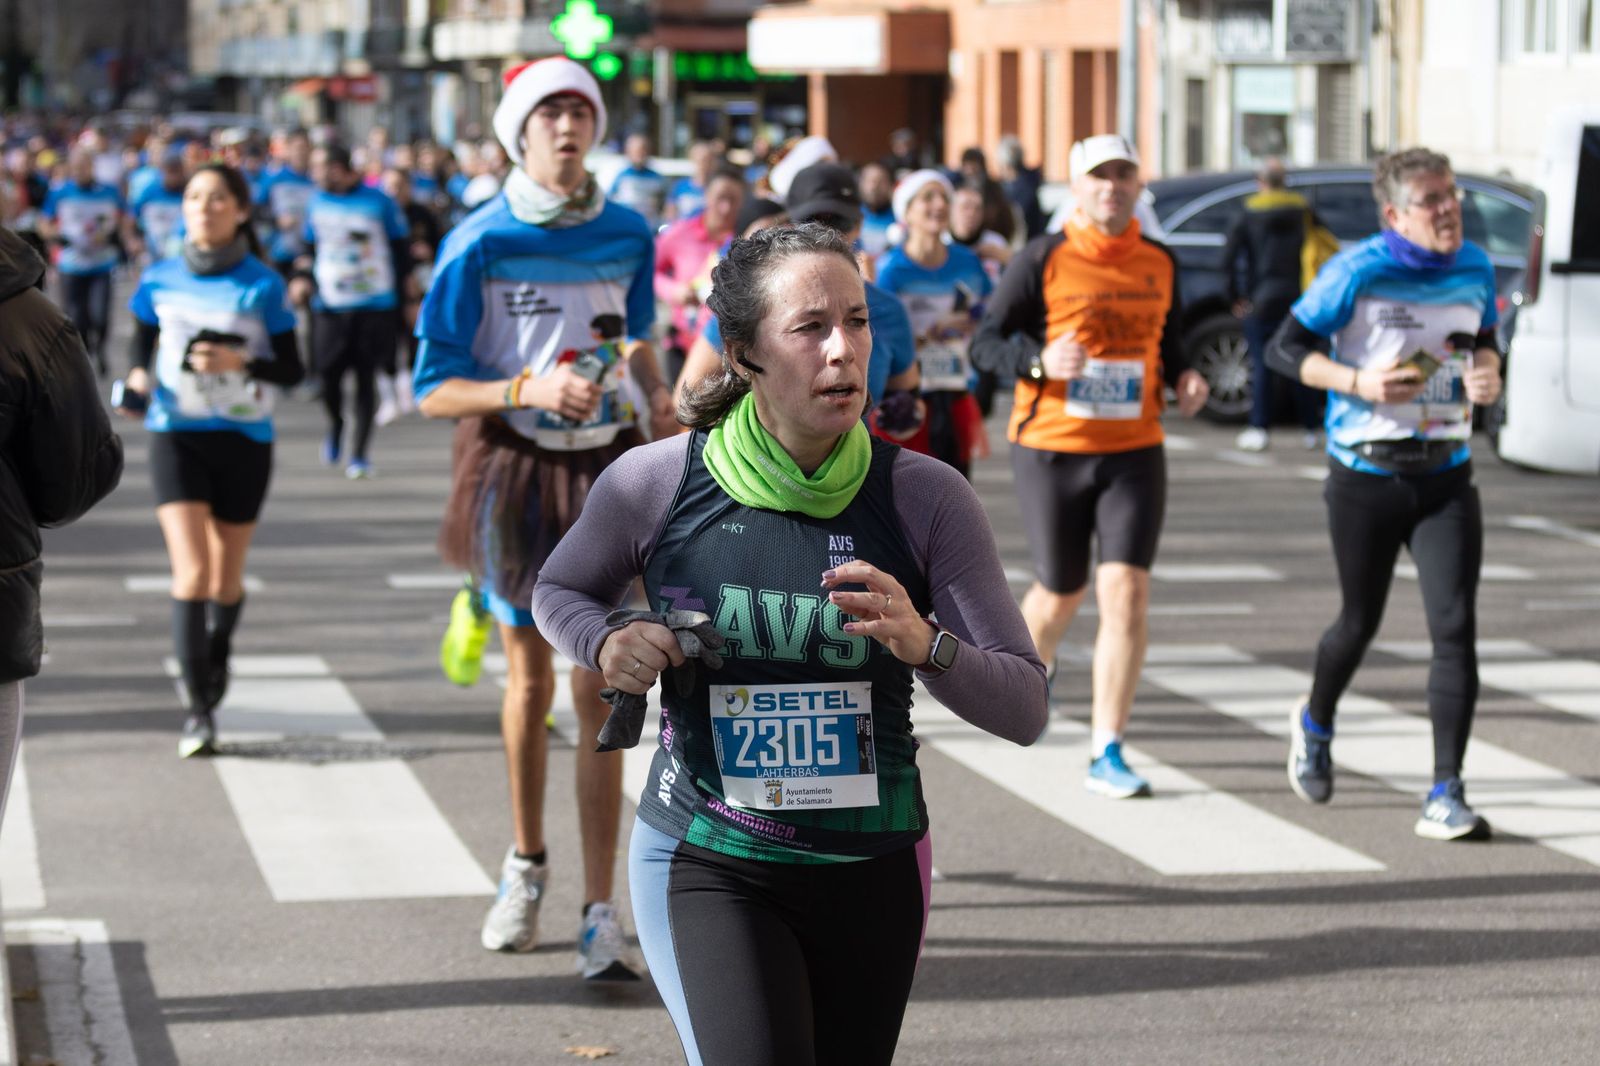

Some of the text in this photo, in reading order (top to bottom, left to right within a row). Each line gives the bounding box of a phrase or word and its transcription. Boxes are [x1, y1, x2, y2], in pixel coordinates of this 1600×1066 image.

[828, 535, 854, 552] AVS
[711, 583, 870, 670] AVS
[753, 690, 858, 712] SETEL
[732, 717, 840, 768] 2305
[755, 767, 820, 778] LAHIERBAS
[658, 768, 676, 808] AVS
[786, 788, 833, 796] Ayuntamiento
[786, 797, 833, 805] de Salamanca
